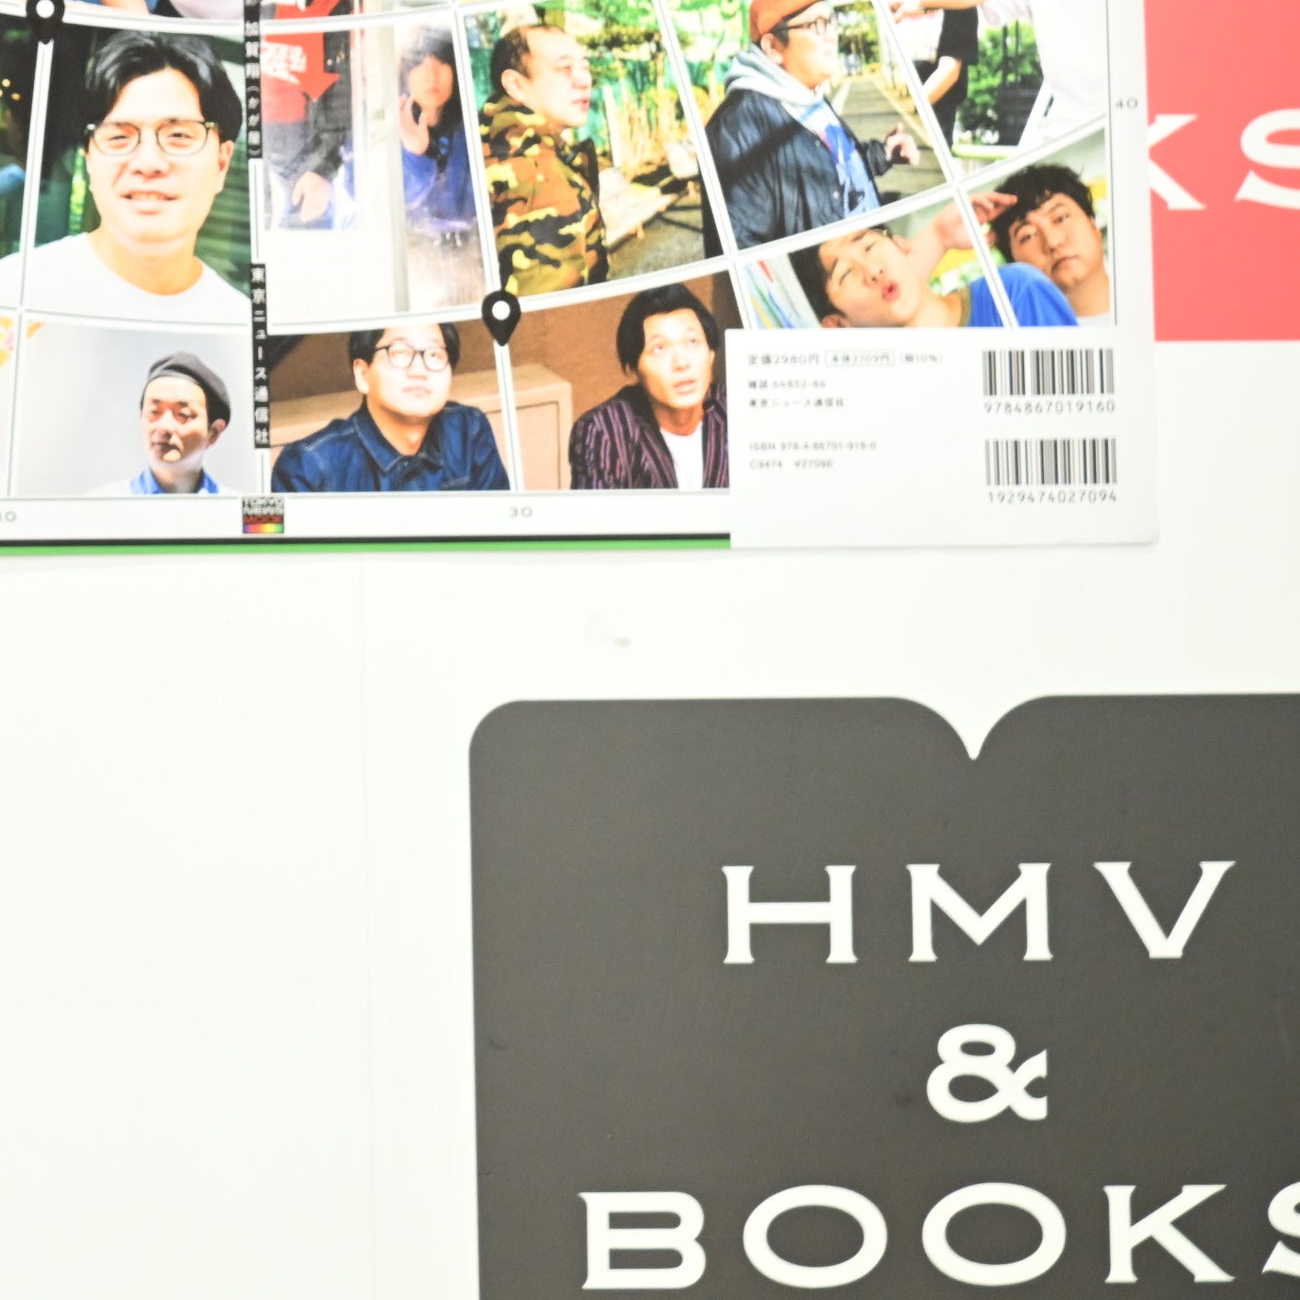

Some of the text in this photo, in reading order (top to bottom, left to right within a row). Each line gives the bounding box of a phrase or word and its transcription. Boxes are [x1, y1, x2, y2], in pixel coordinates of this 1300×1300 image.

[983, 399, 1116, 414] 9784867019160
[721, 860, 1236, 965] HMV
[926, 1023, 1048, 1123] &
